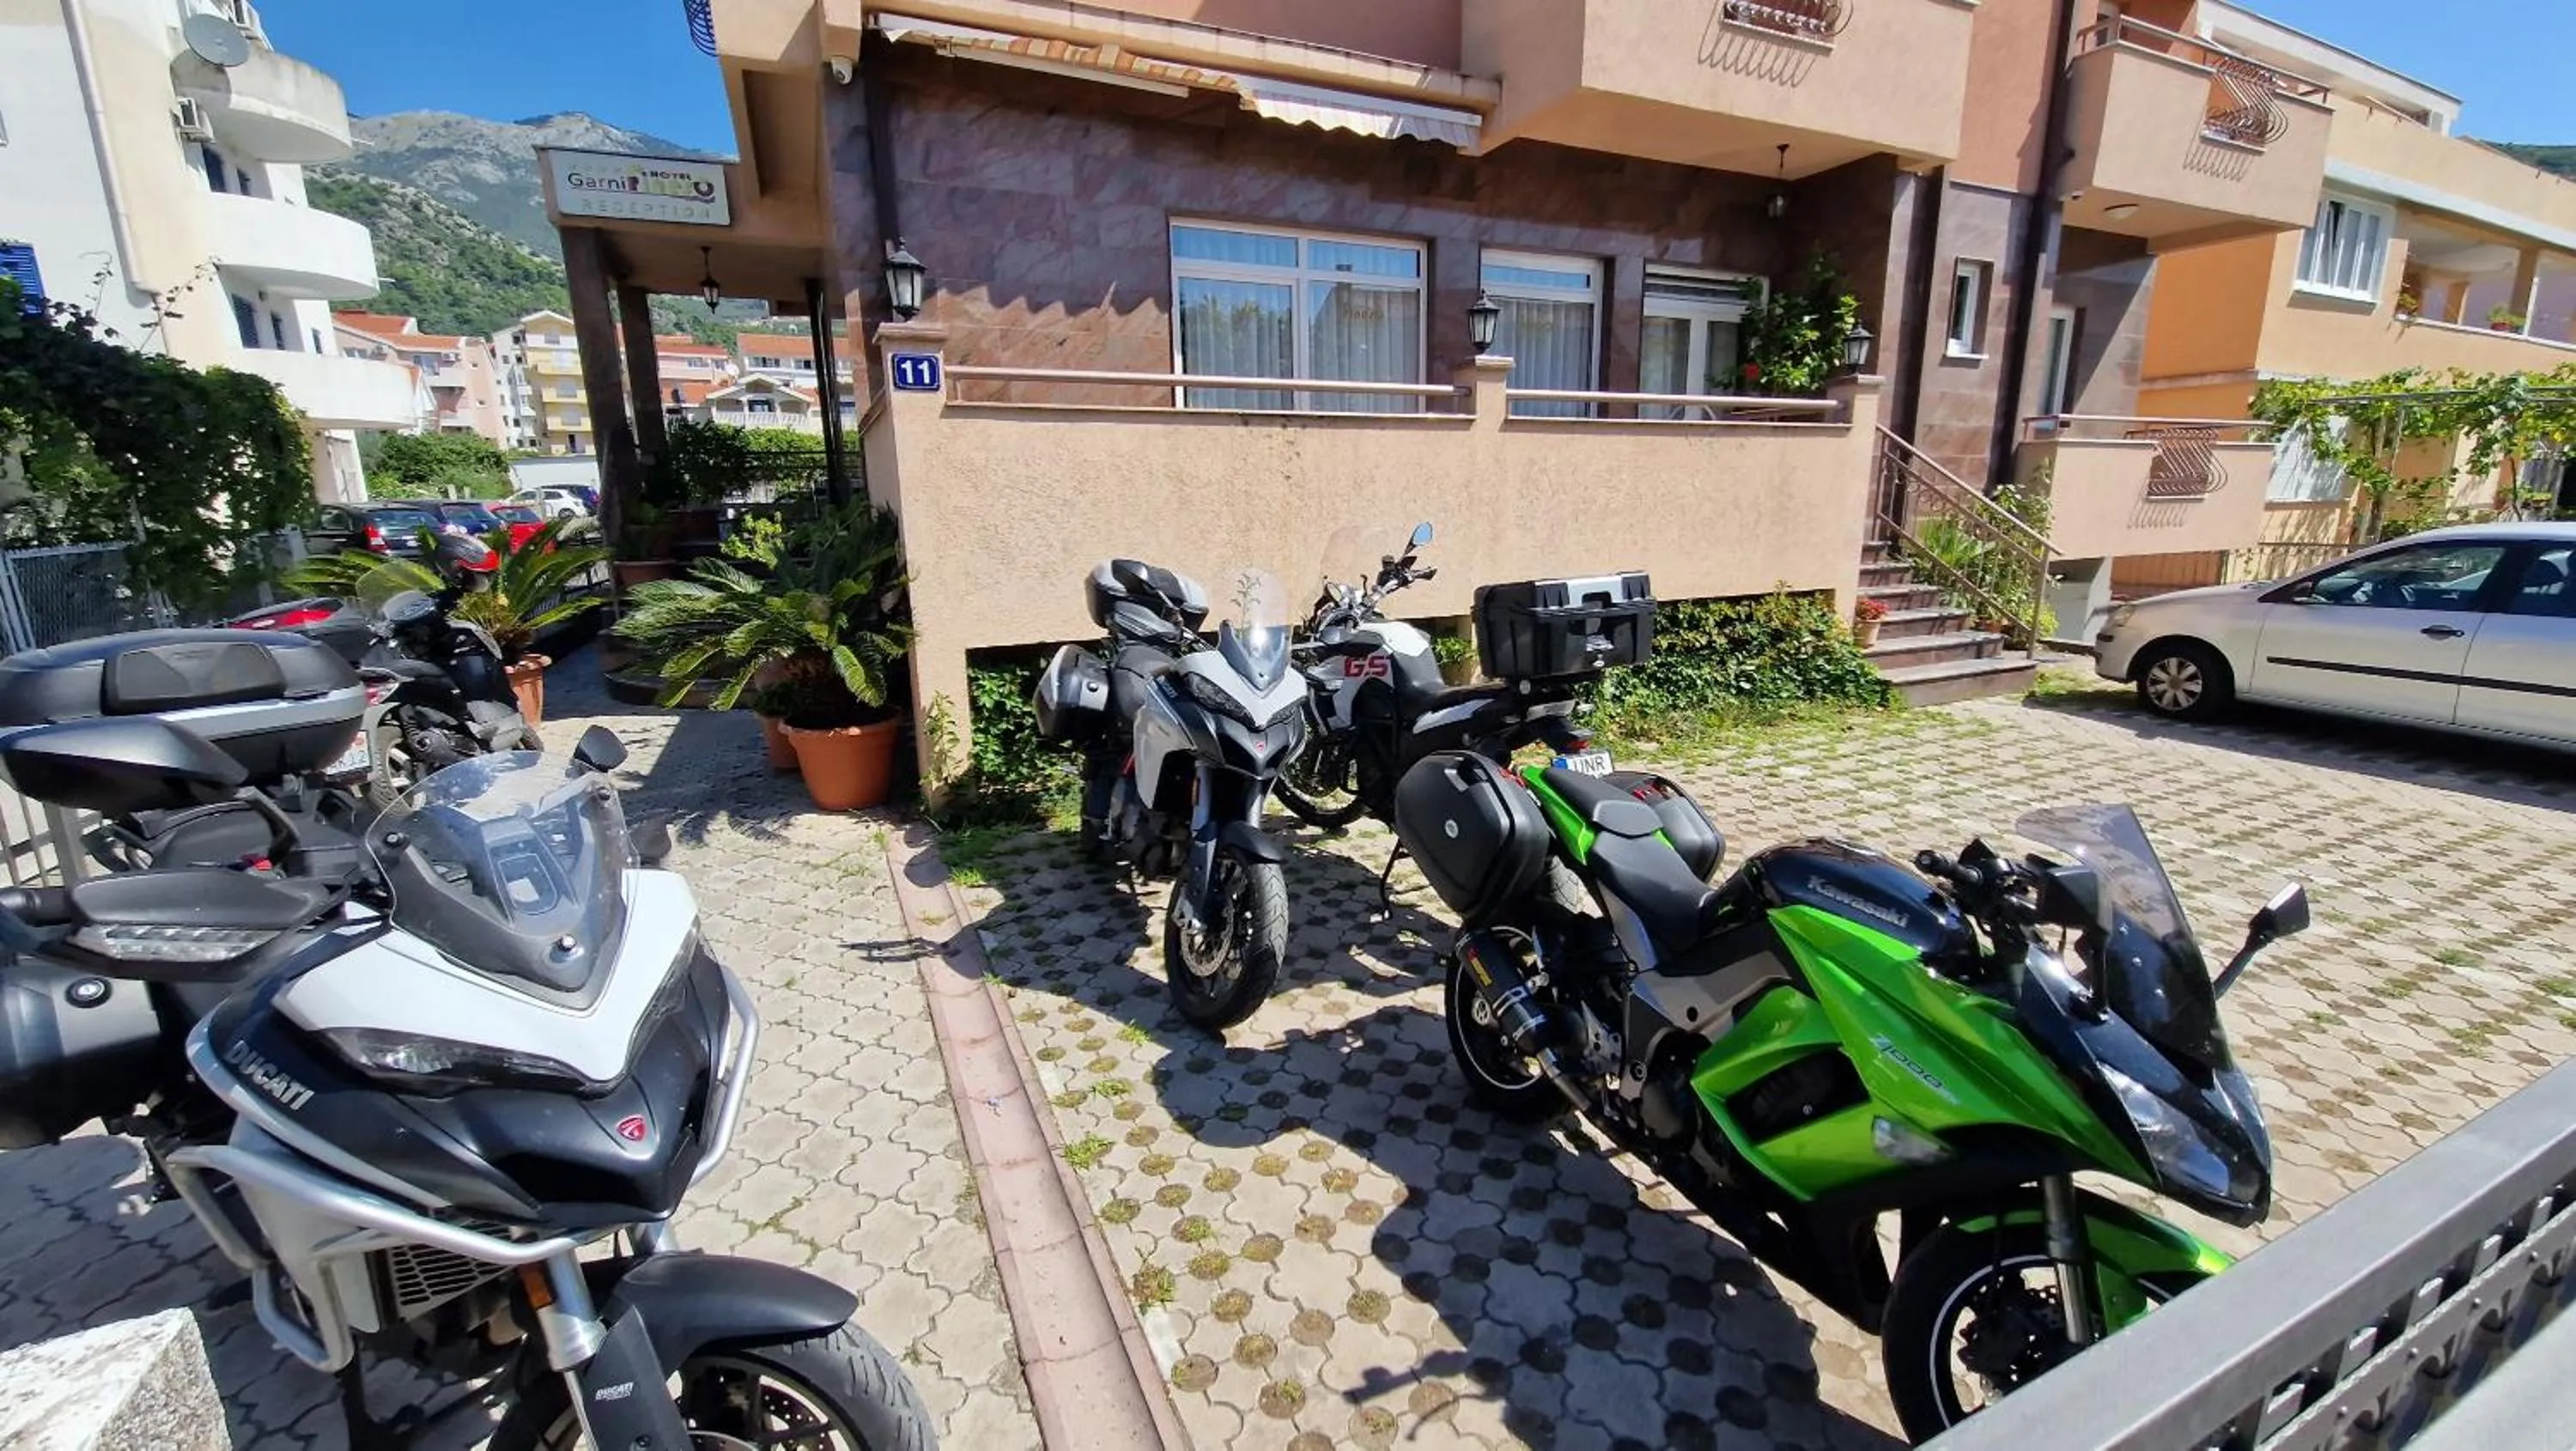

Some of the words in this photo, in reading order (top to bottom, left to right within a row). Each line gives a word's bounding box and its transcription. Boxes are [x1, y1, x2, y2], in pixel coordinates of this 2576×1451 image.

[568, 173, 626, 190] Garni
[901, 360, 930, 384] 11
[1345, 655, 1392, 677] GS
[1807, 876, 1910, 928] Kawasaki
[224, 1040, 315, 1110] DUCATI
